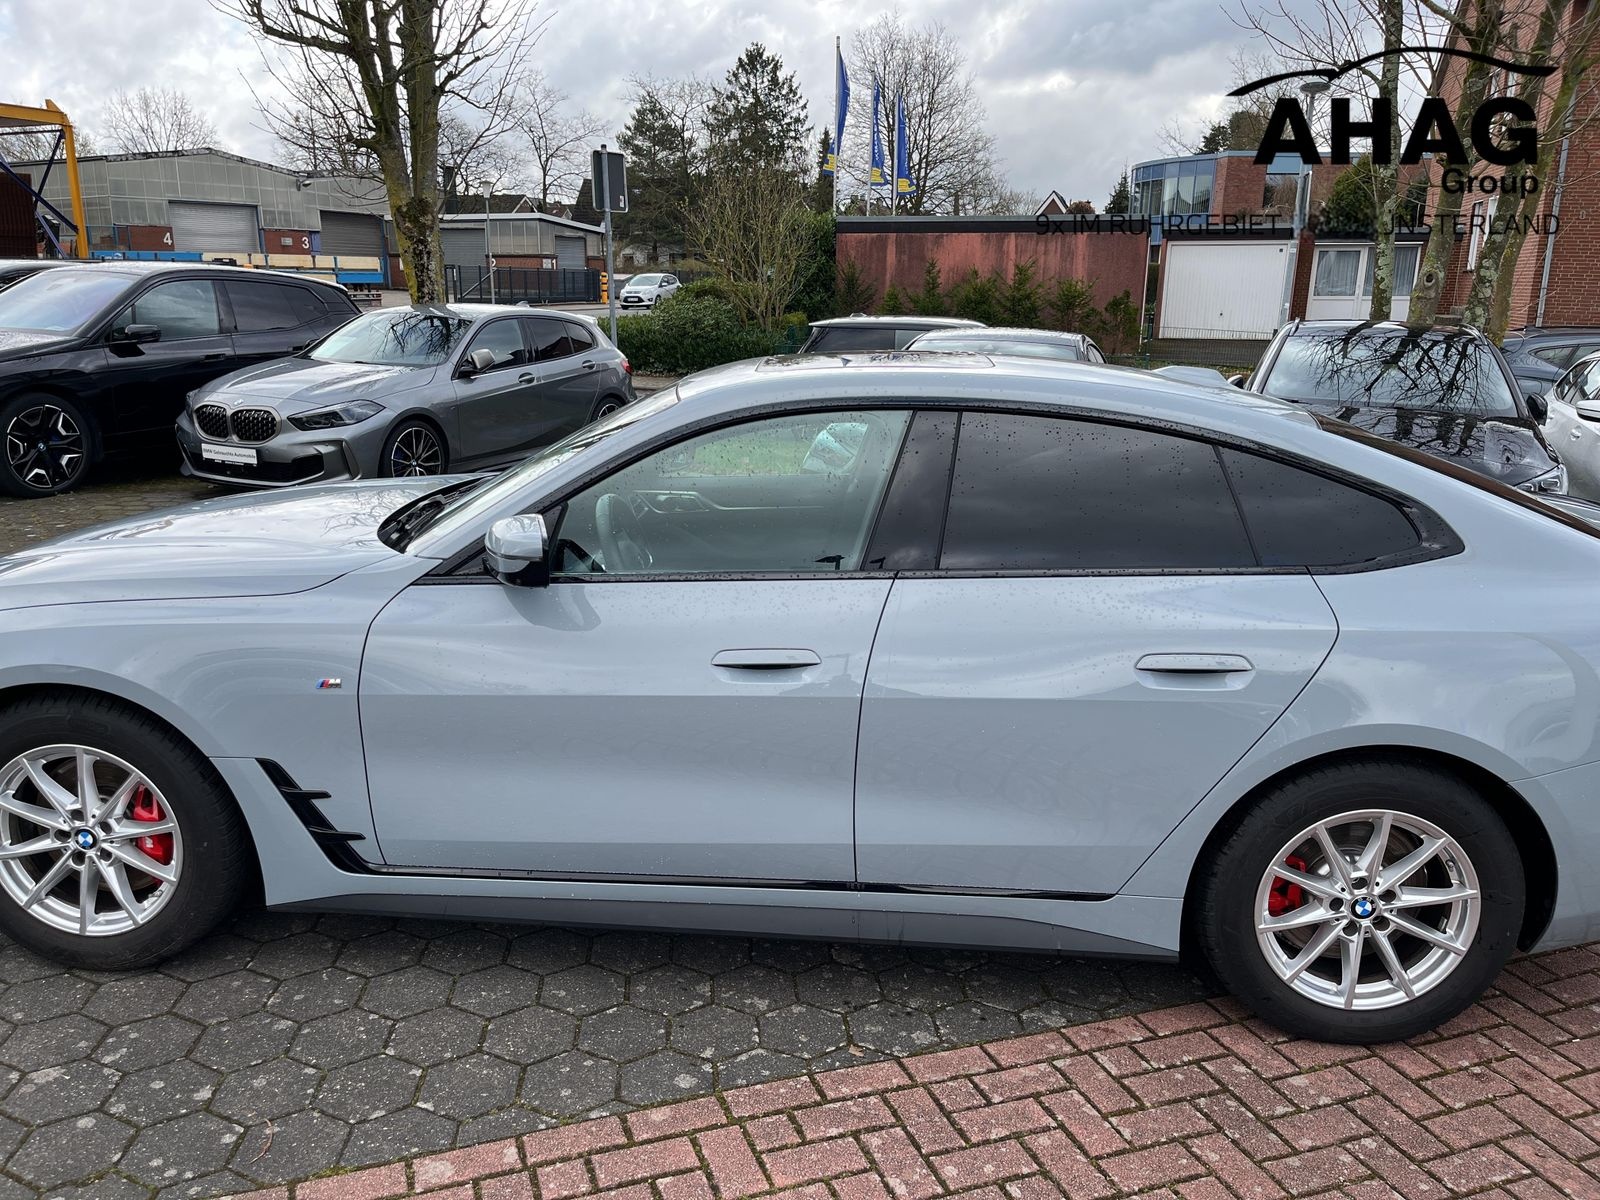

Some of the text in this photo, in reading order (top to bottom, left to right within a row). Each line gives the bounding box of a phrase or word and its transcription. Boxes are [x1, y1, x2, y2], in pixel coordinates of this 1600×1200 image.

[163, 232, 173, 246] 4
[301, 236, 310, 249] 3
[551, 258, 557, 270] 1
